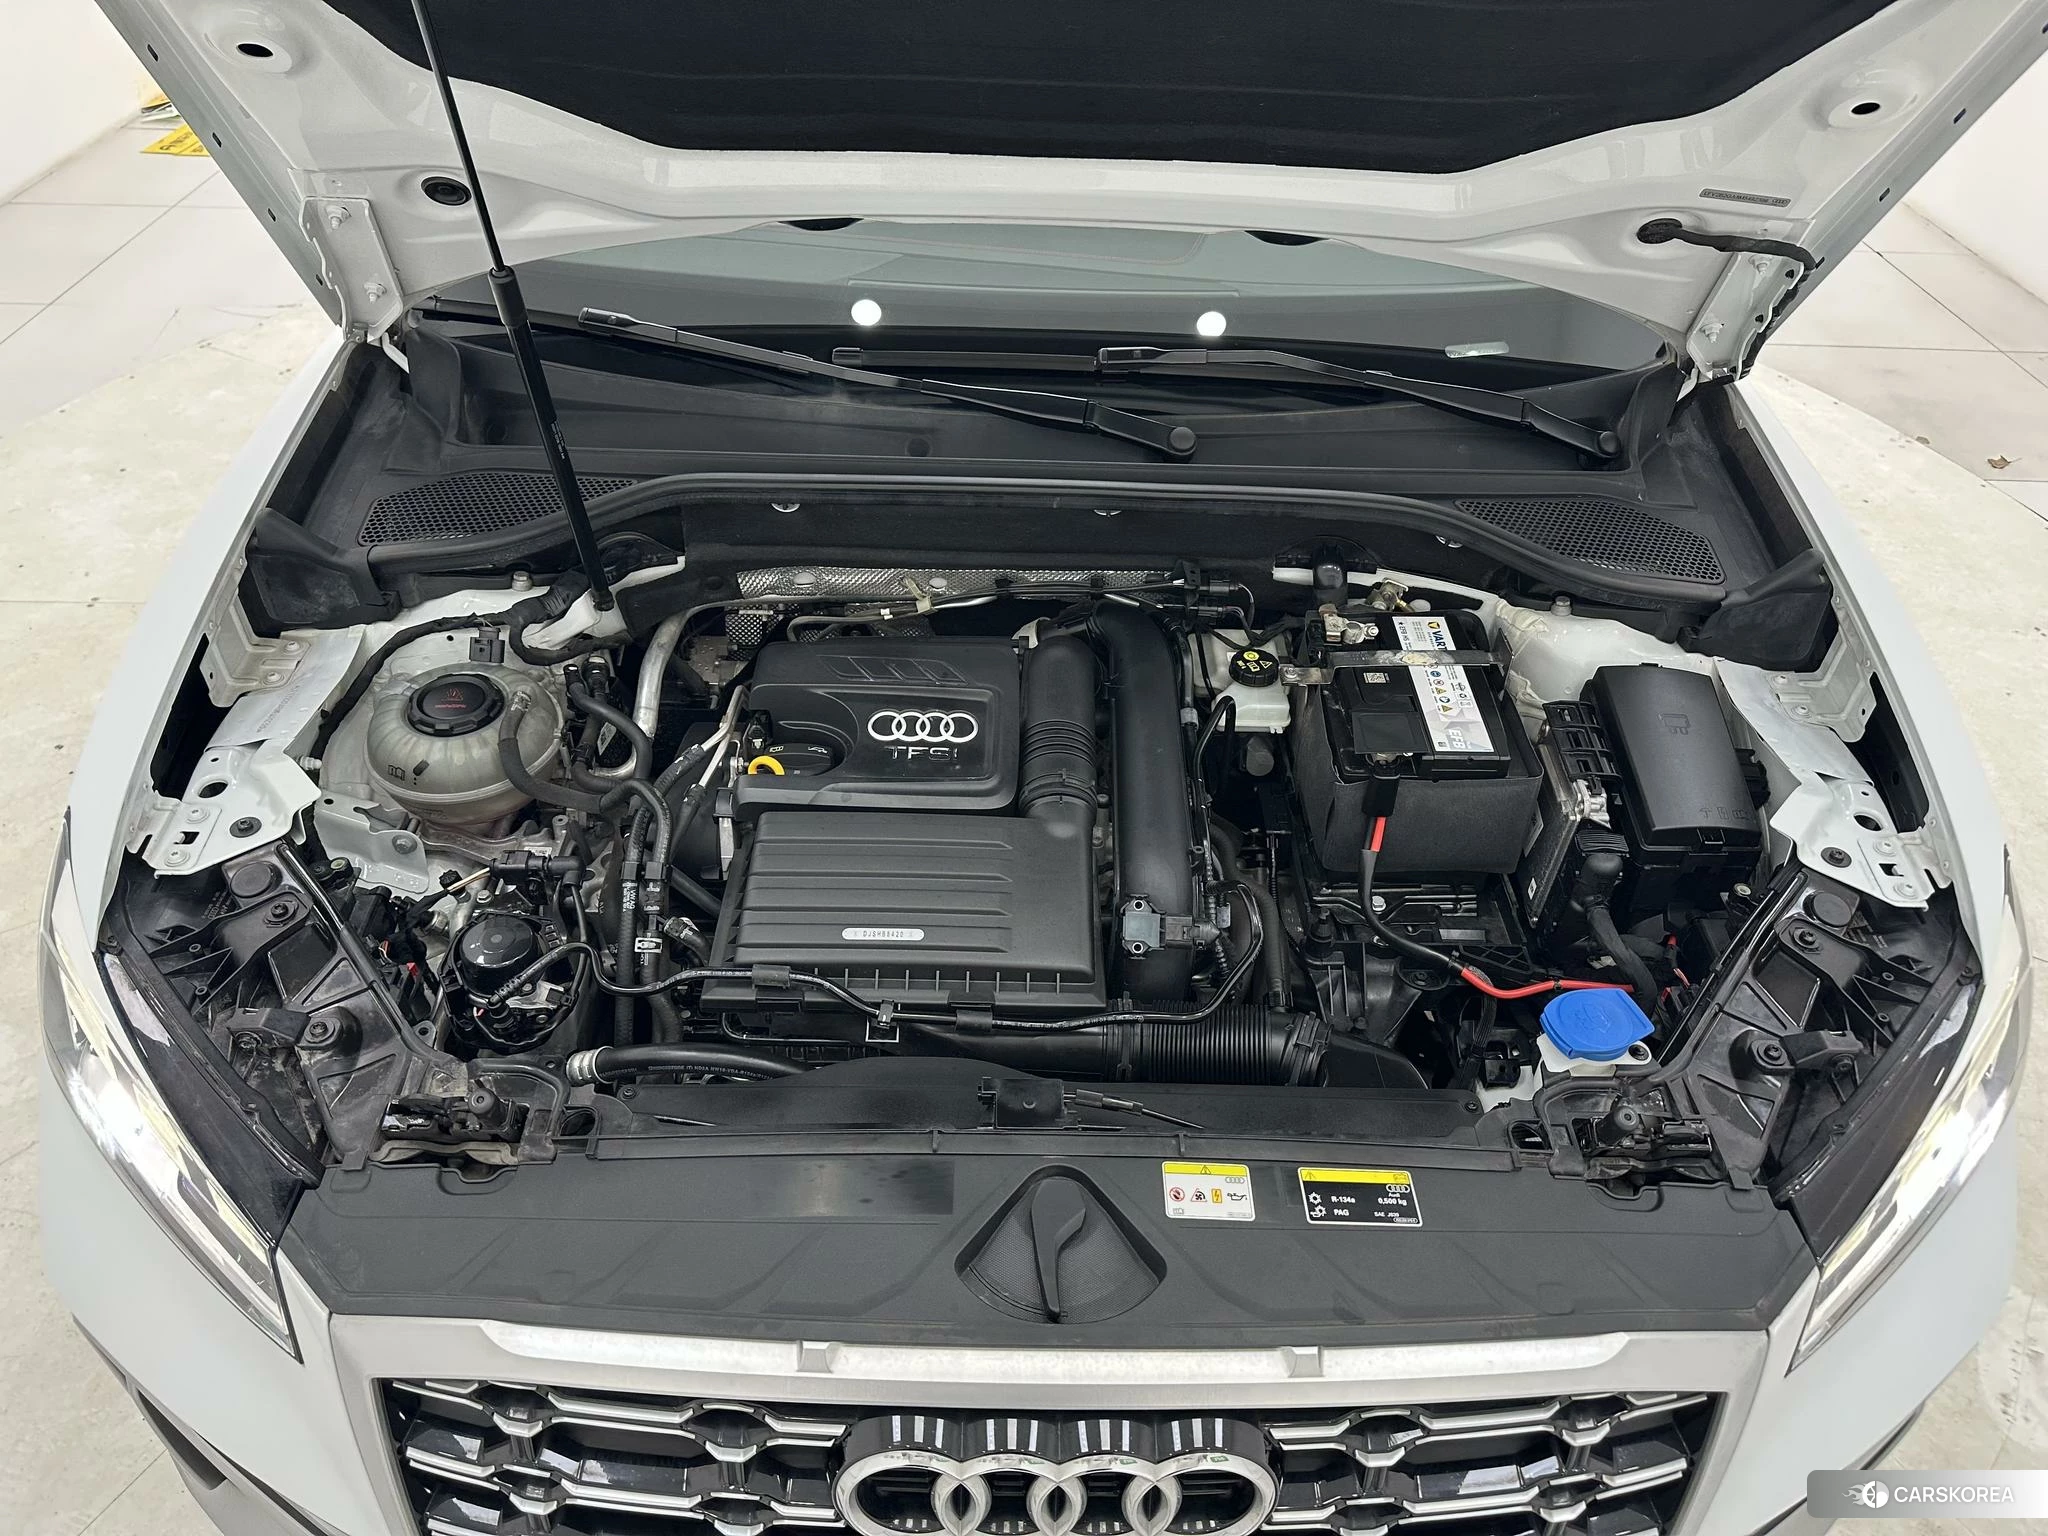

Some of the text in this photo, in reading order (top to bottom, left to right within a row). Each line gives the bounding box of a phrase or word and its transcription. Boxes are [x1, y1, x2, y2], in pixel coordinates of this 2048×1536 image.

[1449, 729, 1466, 749] EFB
[884, 746, 958, 760] TFSI
[1331, 1195, 1356, 1204] R-134a
[1398, 1198, 1408, 1207] kg
